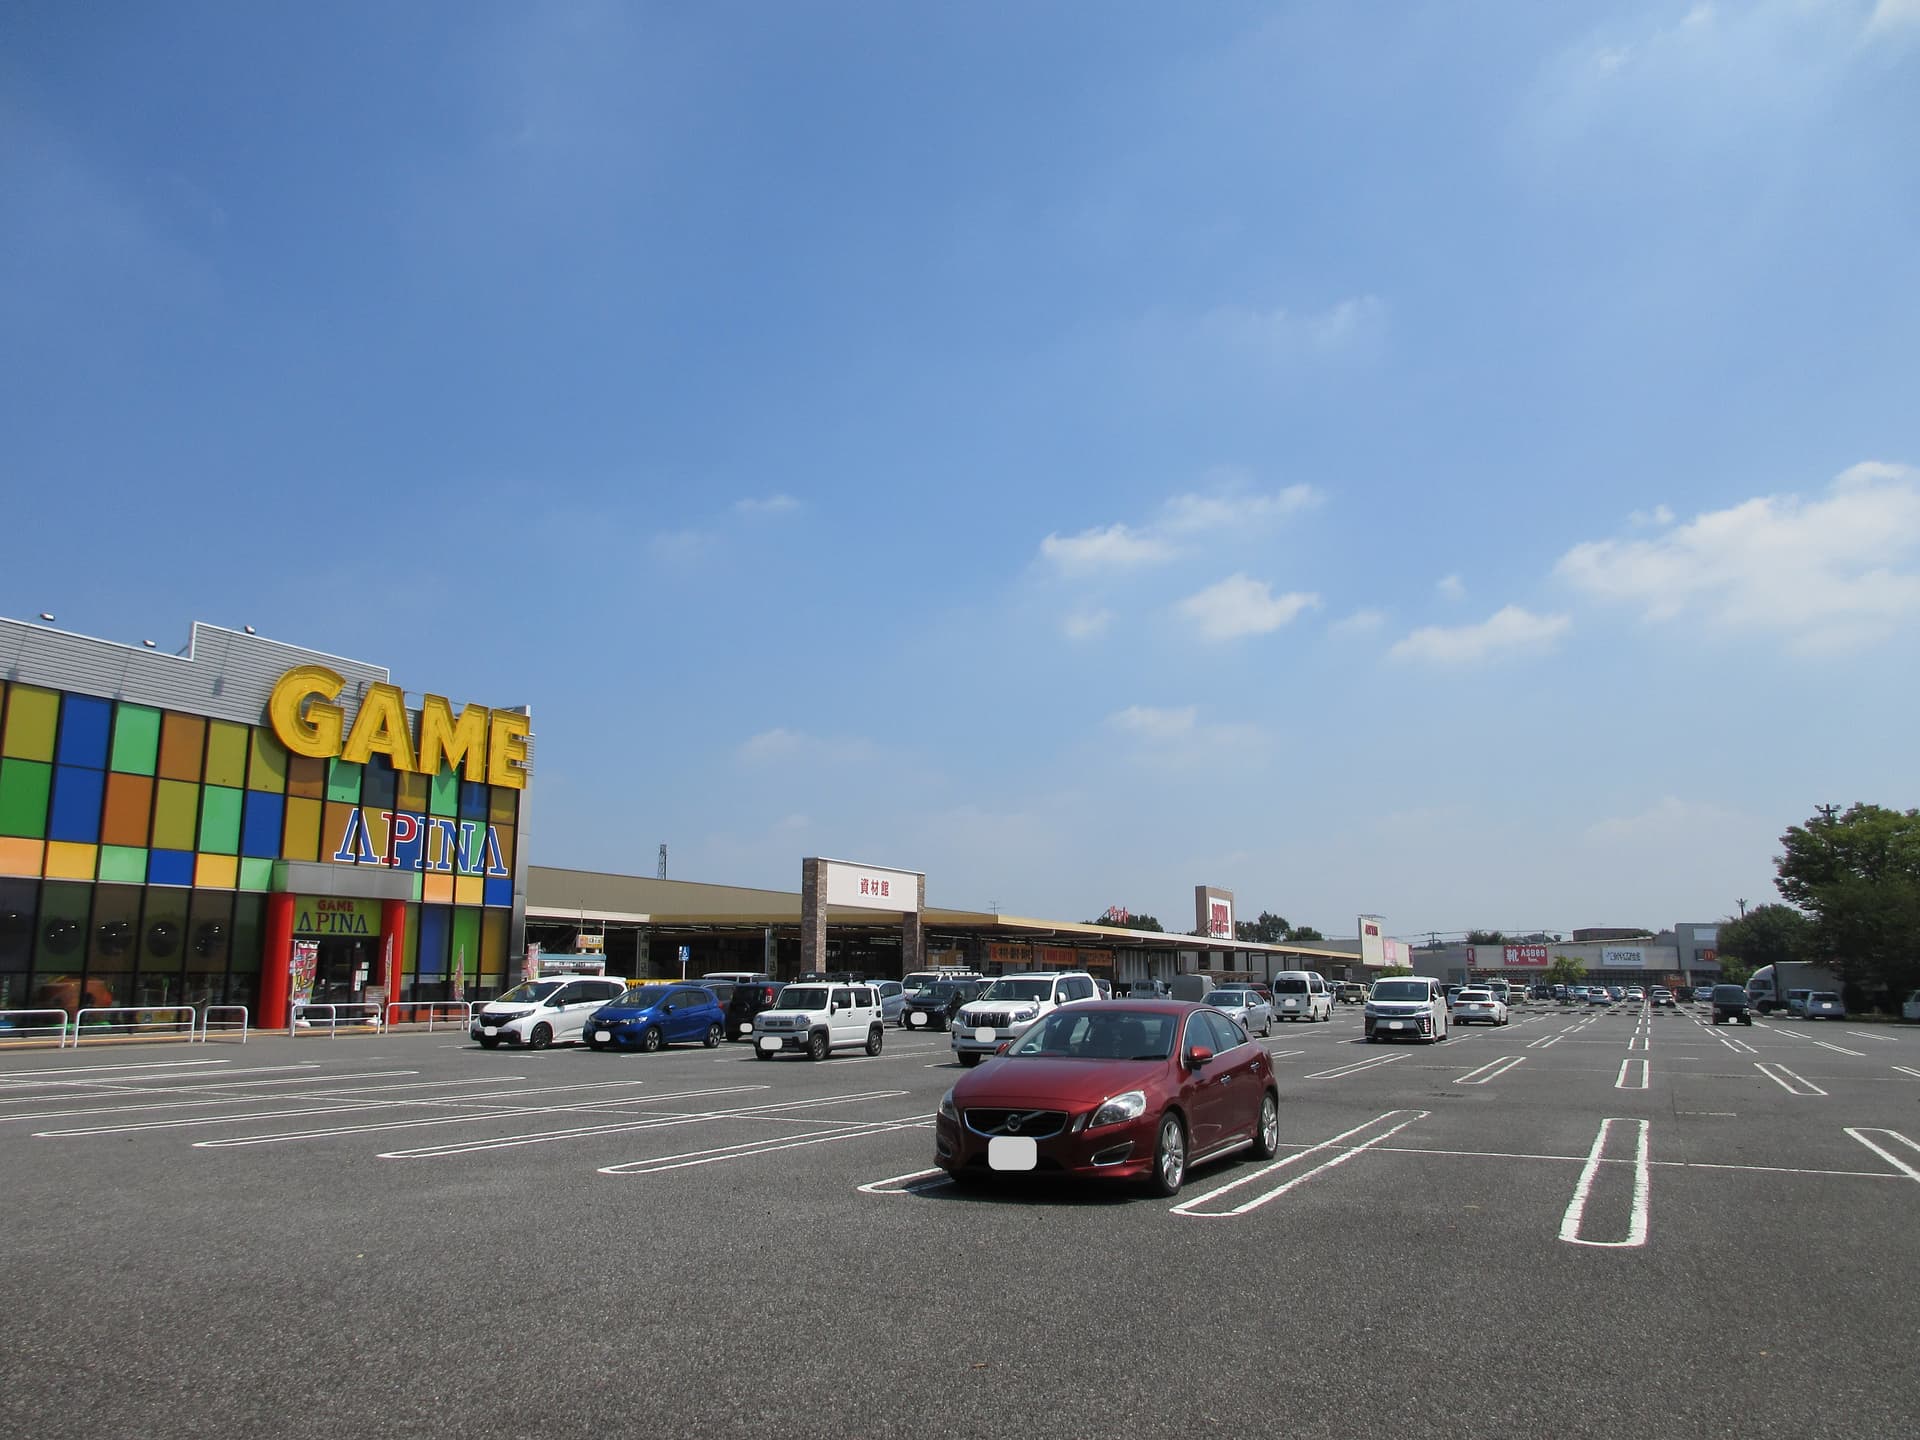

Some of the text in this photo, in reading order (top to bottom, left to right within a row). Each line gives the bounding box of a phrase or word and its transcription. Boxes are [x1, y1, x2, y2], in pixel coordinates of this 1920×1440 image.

[269, 665, 530, 789] GAME
[334, 808, 508, 876] APINA
[860, 877, 889, 896] 資材館
[318, 900, 353, 912] GAME
[296, 912, 368, 933] APINA
